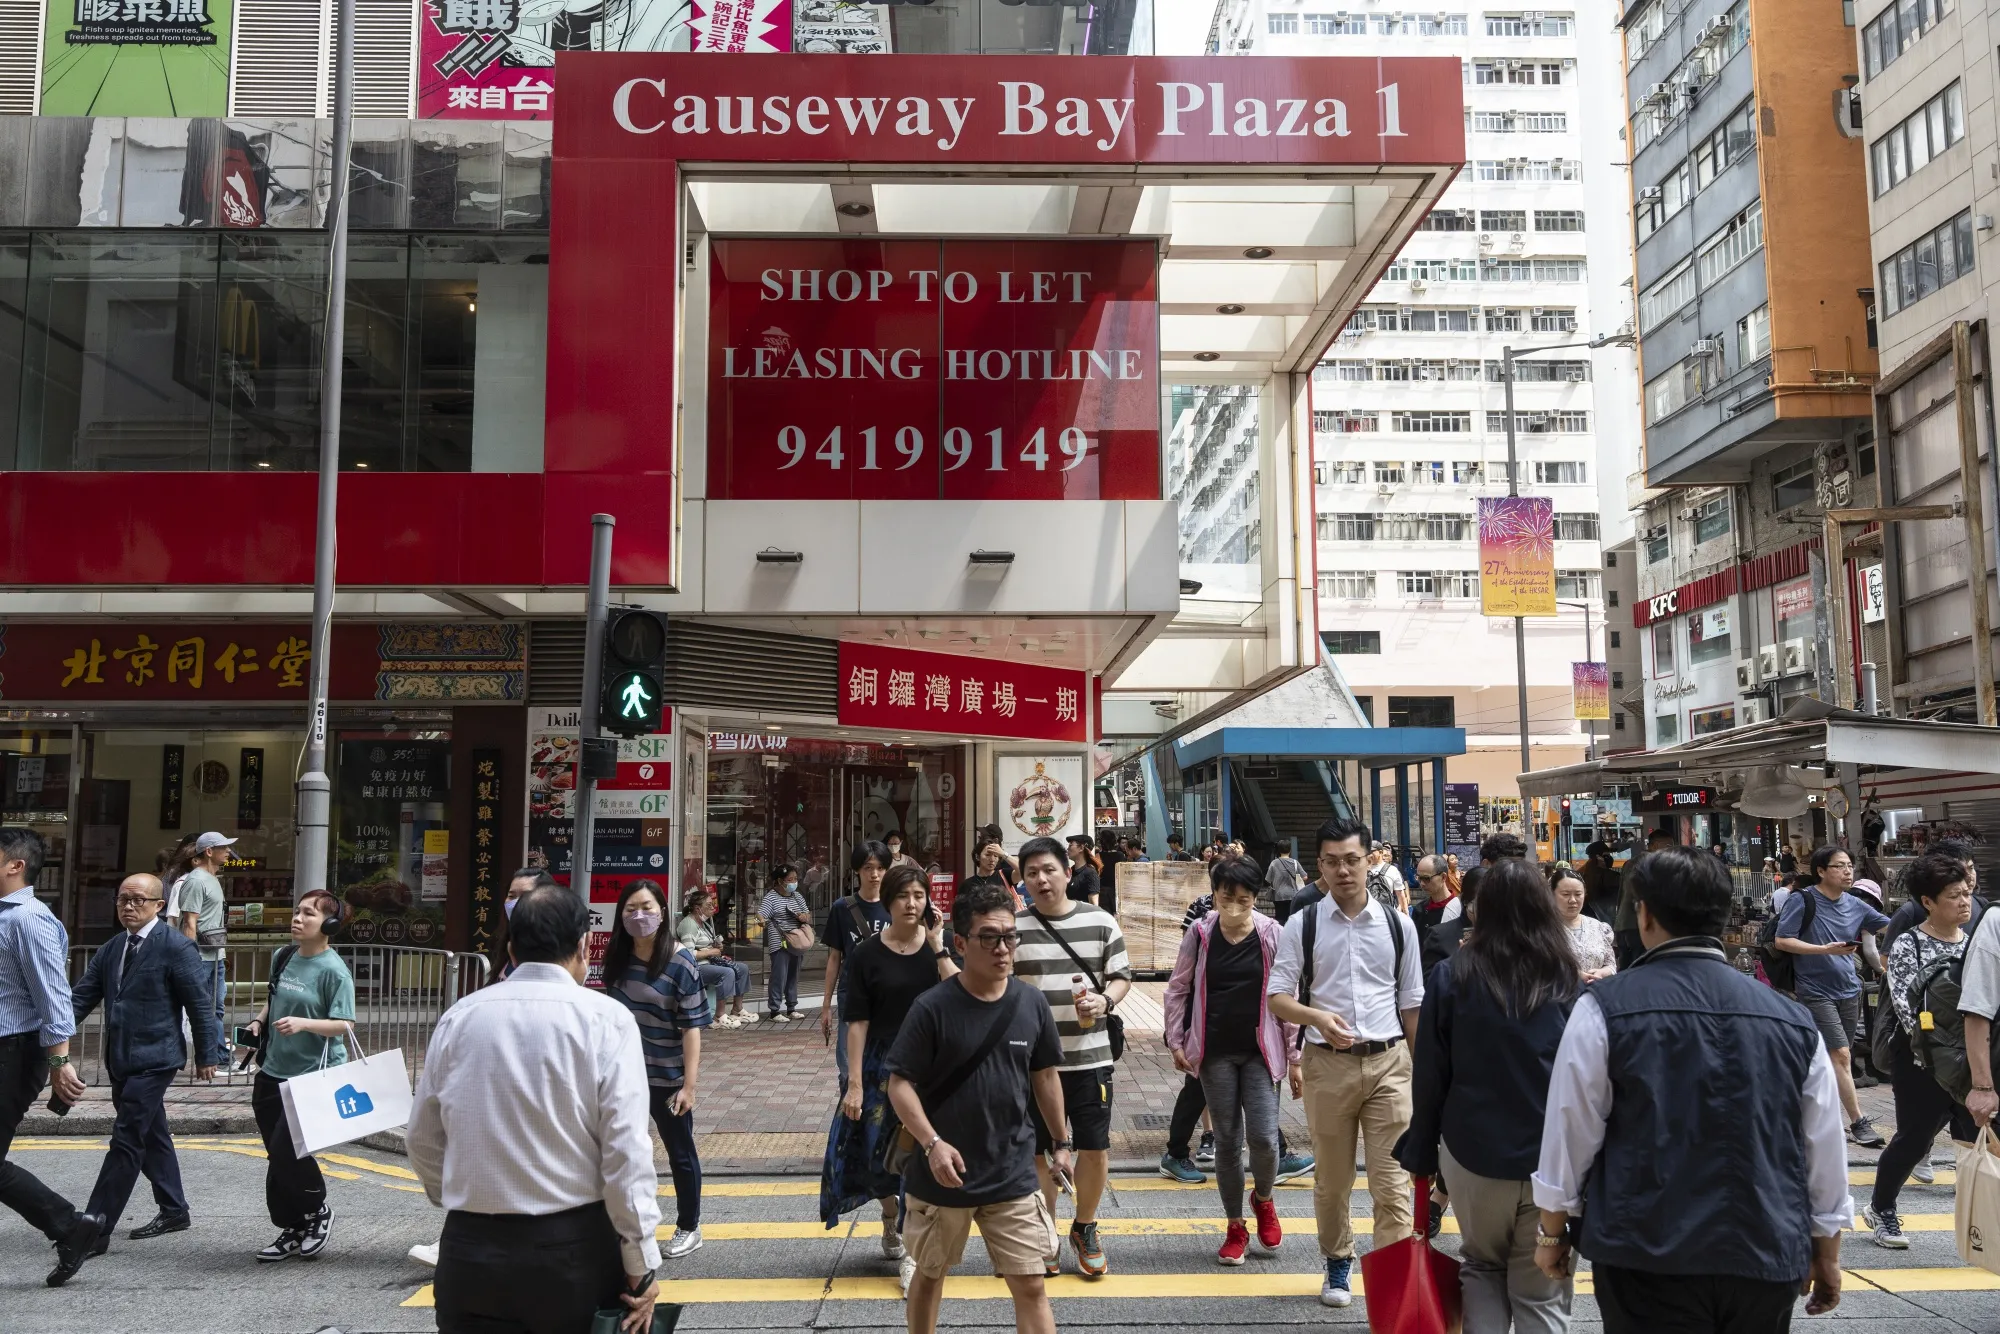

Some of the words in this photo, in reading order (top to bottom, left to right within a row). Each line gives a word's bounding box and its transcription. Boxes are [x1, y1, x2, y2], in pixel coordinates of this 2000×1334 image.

[105, 27, 125, 35] soup
[127, 26, 155, 35] ignites
[69, 33, 110, 41] freshness
[111, 34, 144, 42] spreads
[182, 34, 213, 43] tongue.
[447, 75, 554, 111] 來自台
[612, 77, 976, 151] Causeway
[997, 81, 1136, 152] Bay
[1155, 81, 1352, 137] Plaza
[1375, 81, 1410, 137] 1
[760, 268, 894, 302] SHOP
[908, 270, 979, 303] TO
[996, 271, 1093, 304] LET
[721, 347, 924, 380] LEASING
[944, 348, 1144, 381] HOTLINE
[1503, 565, 1550, 579] Anniversary
[1491, 578, 1498, 588] of
[1499, 578, 1508, 586] the
[1508, 578, 1549, 586] Establishment
[1510, 586, 1517, 595] of
[1519, 586, 1527, 594] the
[1529, 586, 1550, 595] HKSAR
[1649, 590, 1678, 620] KFC
[61, 634, 313, 689] 北京同仁堂
[847, 665, 1079, 723] 銅鑼灣廣場一期
[316, 701, 326, 741] 46119
[637, 738, 668, 758] 8F
[370, 769, 427, 783] 免疫力好
[642, 767, 652, 778] 7
[361, 785, 433, 799] 健康自然好
[1672, 792, 1700, 804] TUDOR
[639, 794, 669, 813] 6F
[355, 825, 391, 837] 100%
[607, 827, 618, 835] AH
[618, 827, 635, 835] RUM
[646, 827, 663, 838] 6/F
[355, 839, 390, 850] 赤靈芝
[650, 857, 663, 865] 4/F
